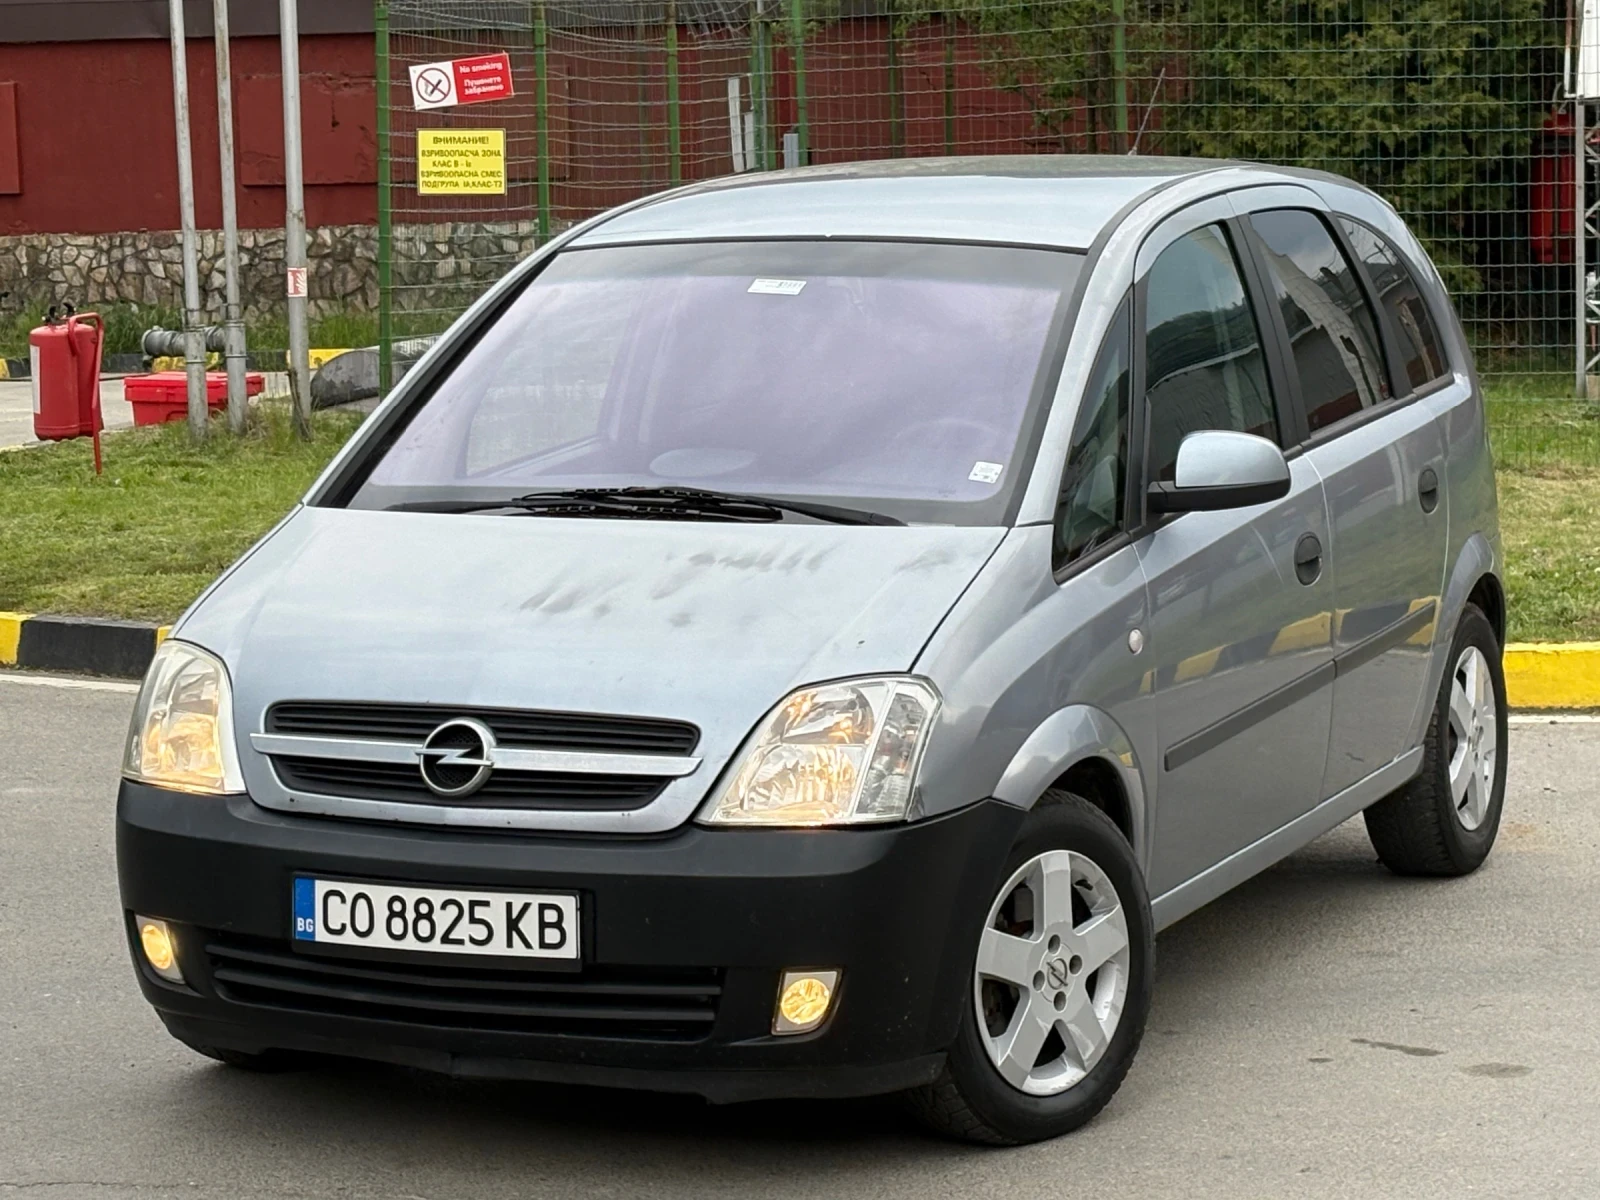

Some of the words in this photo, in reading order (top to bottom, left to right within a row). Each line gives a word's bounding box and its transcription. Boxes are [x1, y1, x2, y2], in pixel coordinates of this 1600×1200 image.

[459, 65, 470, 74] No
[471, 62, 503, 73] smoking
[432, 136, 489, 145] ВНИМАНИЕ!
[421, 149, 479, 157] ВЗРИВООПАСНА
[481, 149, 501, 157] ЗОНА
[432, 160, 452, 168] КЛАС
[421, 170, 479, 178] ВЗРИВООПАСНА
[422, 180, 460, 188] ПОДГРУПА
[322, 889, 375, 938] CO
[385, 895, 494, 947] 8825
[505, 901, 567, 950] KB
[296, 917, 314, 933] BG
